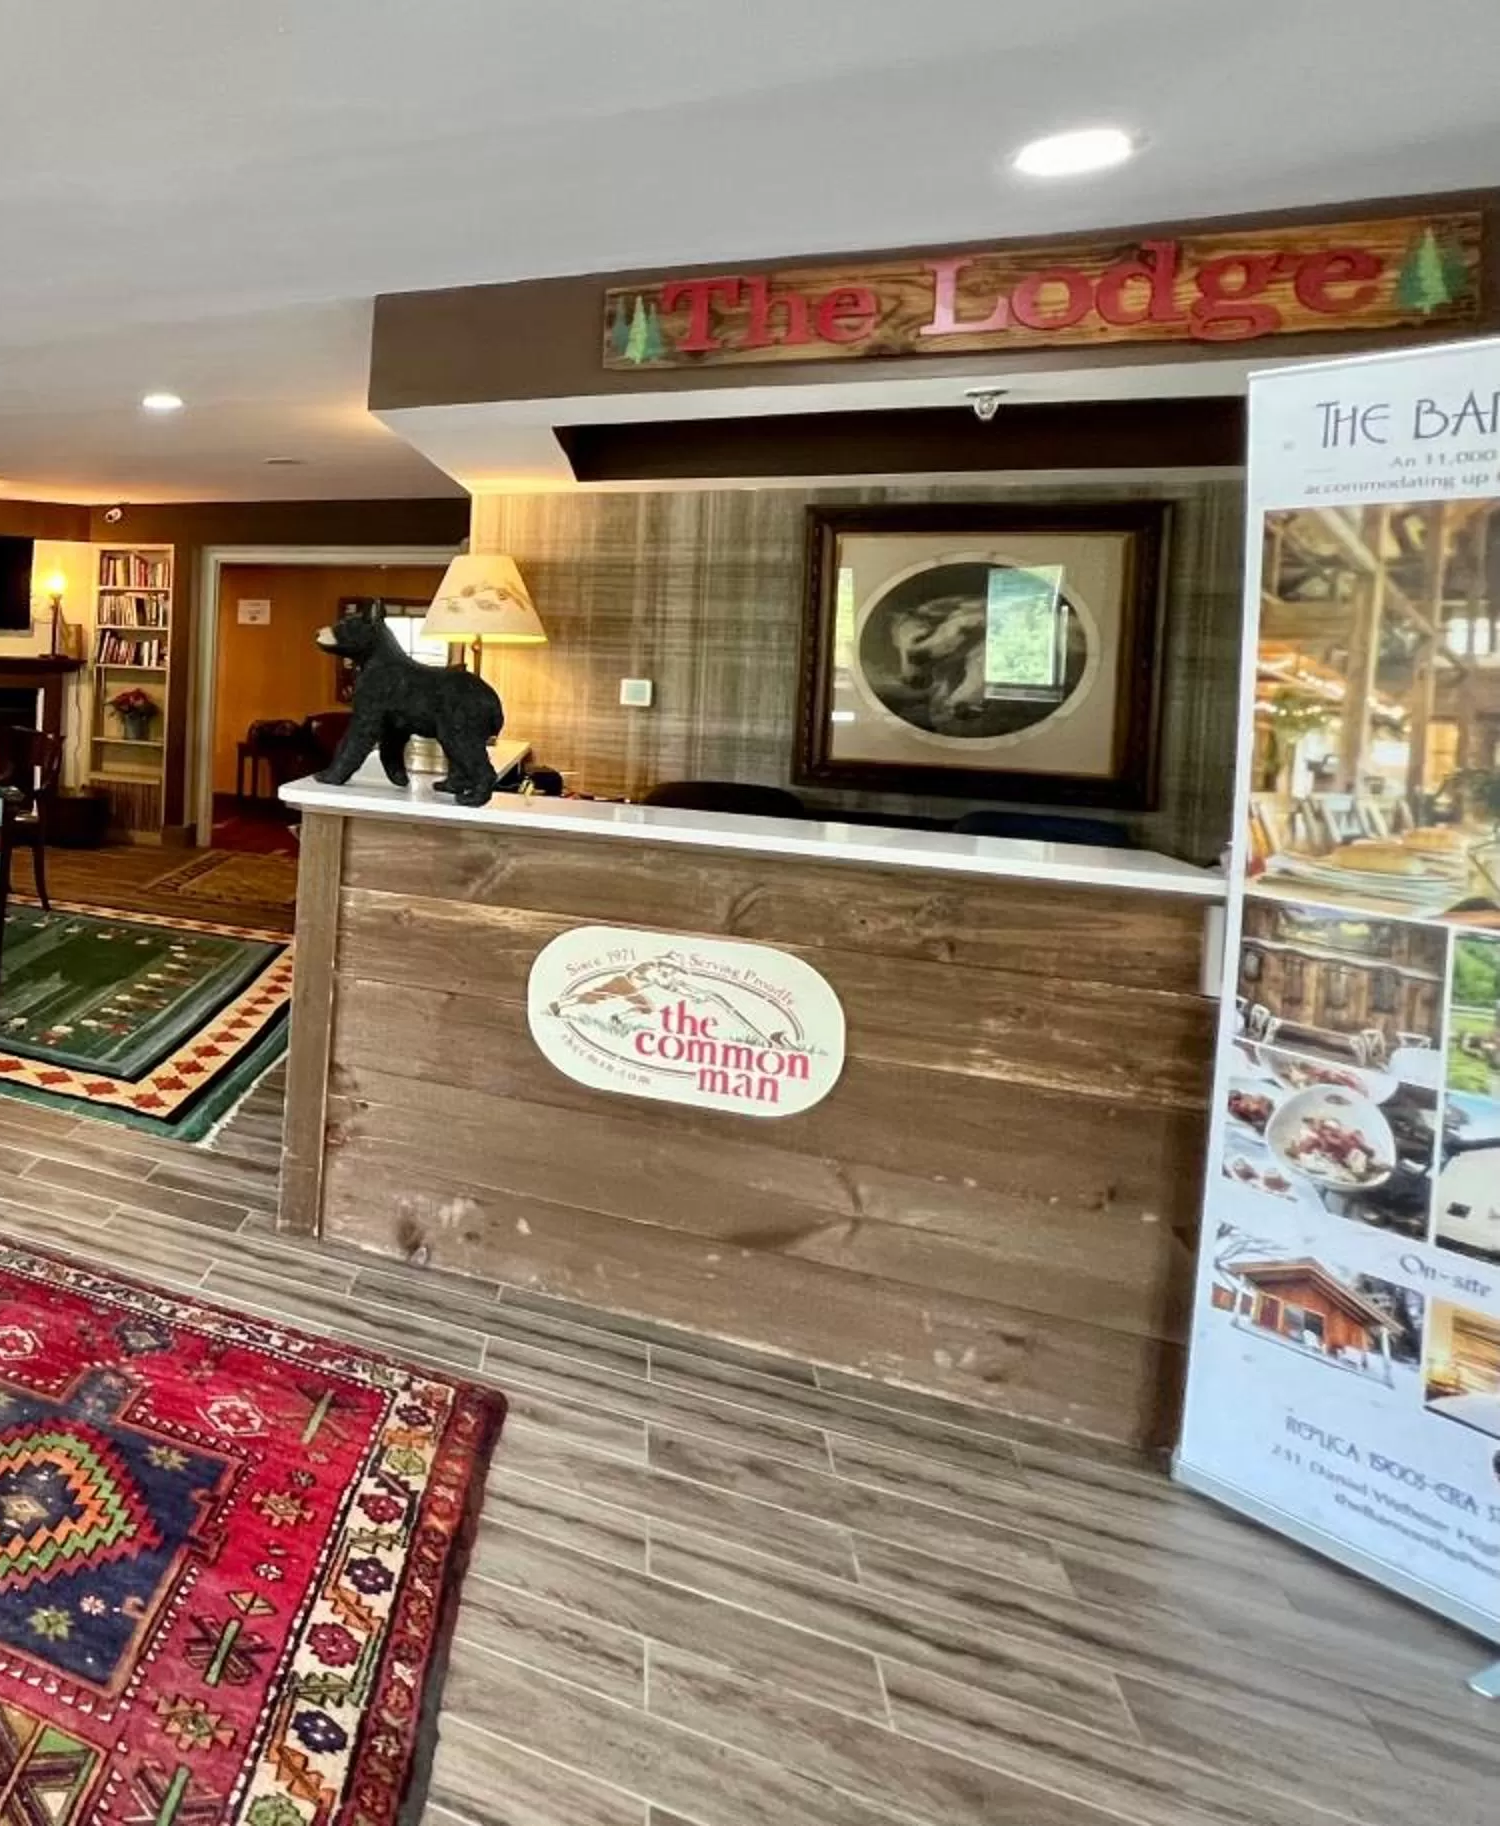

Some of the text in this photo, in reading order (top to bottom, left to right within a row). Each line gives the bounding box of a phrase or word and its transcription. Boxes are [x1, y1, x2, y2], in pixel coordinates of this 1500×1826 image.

[660, 238, 1384, 353] The Lodge
[1316, 401, 1390, 448] THE
[1304, 474, 1456, 494] accommodating
[564, 957, 601, 978] Since
[689, 953, 741, 980] Serving
[660, 1000, 718, 1040] the
[635, 1031, 811, 1080] common
[697, 1067, 779, 1104] man
[1399, 1253, 1494, 1298] On-site
[1285, 1415, 1360, 1464] REPLICA
